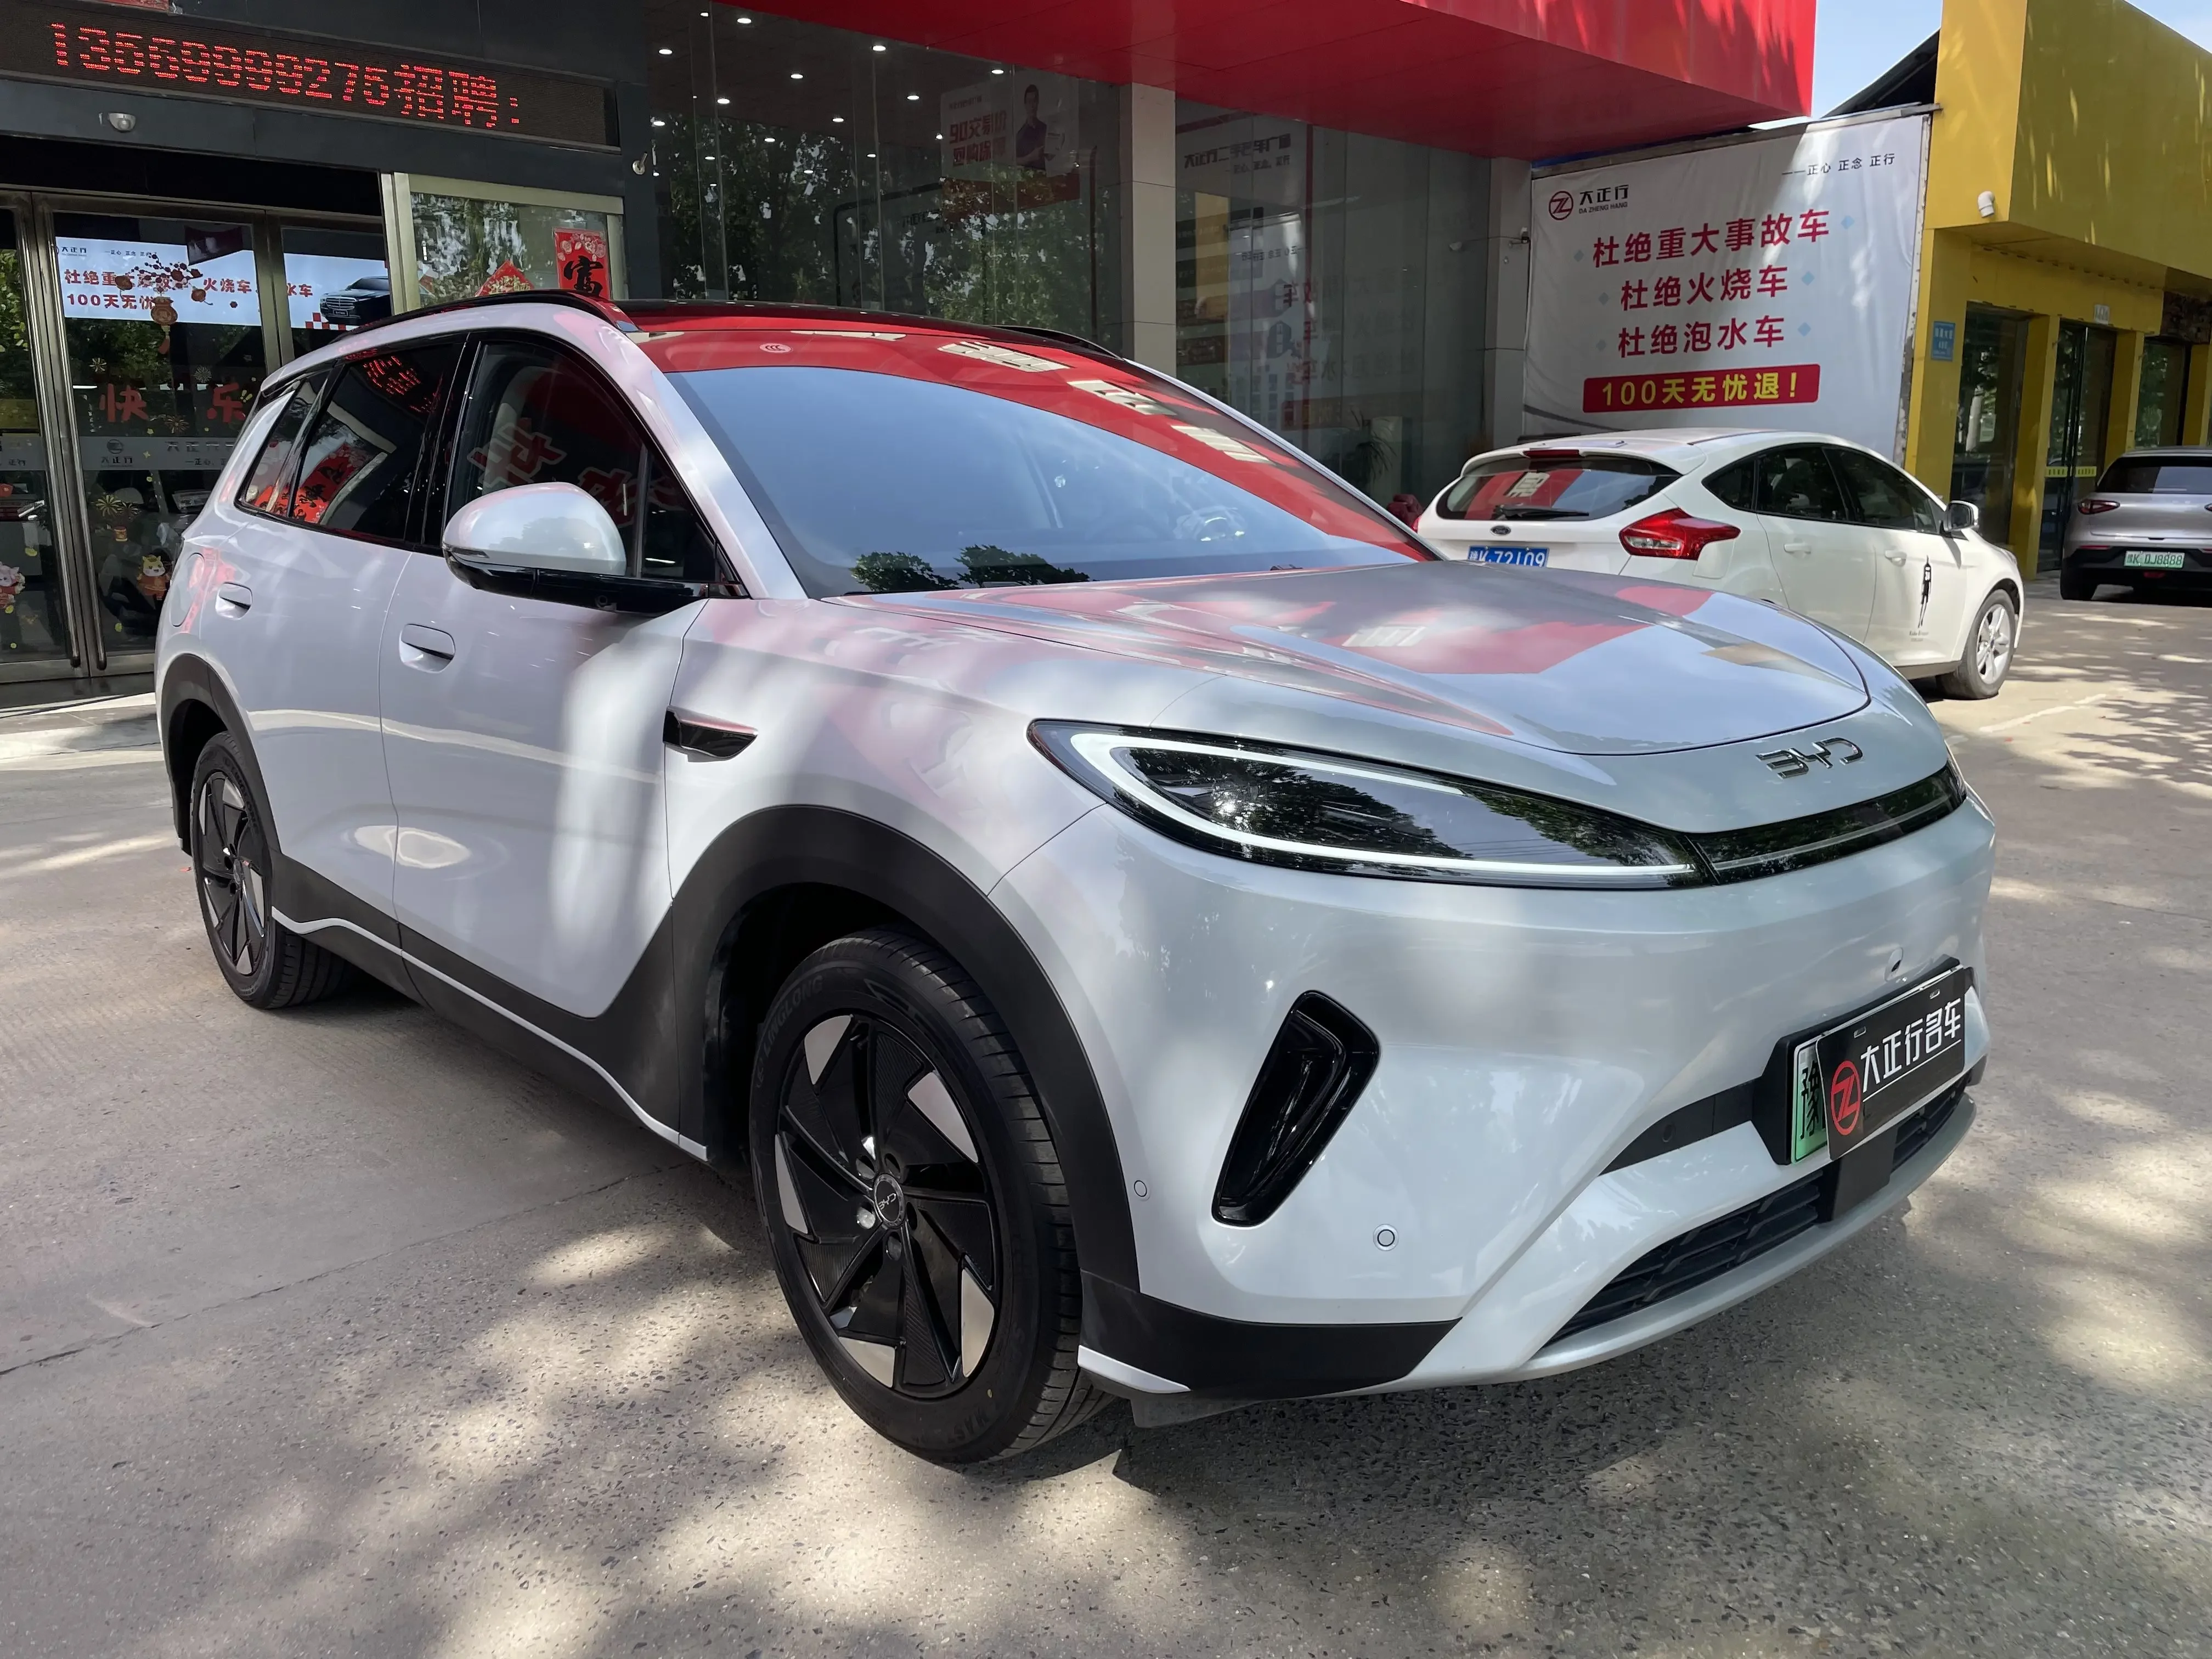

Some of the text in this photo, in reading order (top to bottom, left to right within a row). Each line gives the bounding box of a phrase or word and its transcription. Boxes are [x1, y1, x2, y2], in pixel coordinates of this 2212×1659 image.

[1838, 157, 1863, 172] 正念
[1869, 153, 1895, 167] 正行
[1579, 184, 1629, 206] 大正行
[1588, 205, 1609, 213] ZHENG
[1593, 208, 1830, 268] 杜绝重大事故车
[204, 278, 252, 294] 火烧车
[1619, 264, 1788, 311] 杜绝火烧车
[1618, 315, 1785, 358] 杜绝泡水车
[99, 382, 246, 424] 快 乐
[1756, 737, 1864, 779] BYD
[763, 974, 824, 1058] LINGLONG
[1860, 998, 1962, 1093] 大正行名车
[878, 1193, 896, 1211] BYD
